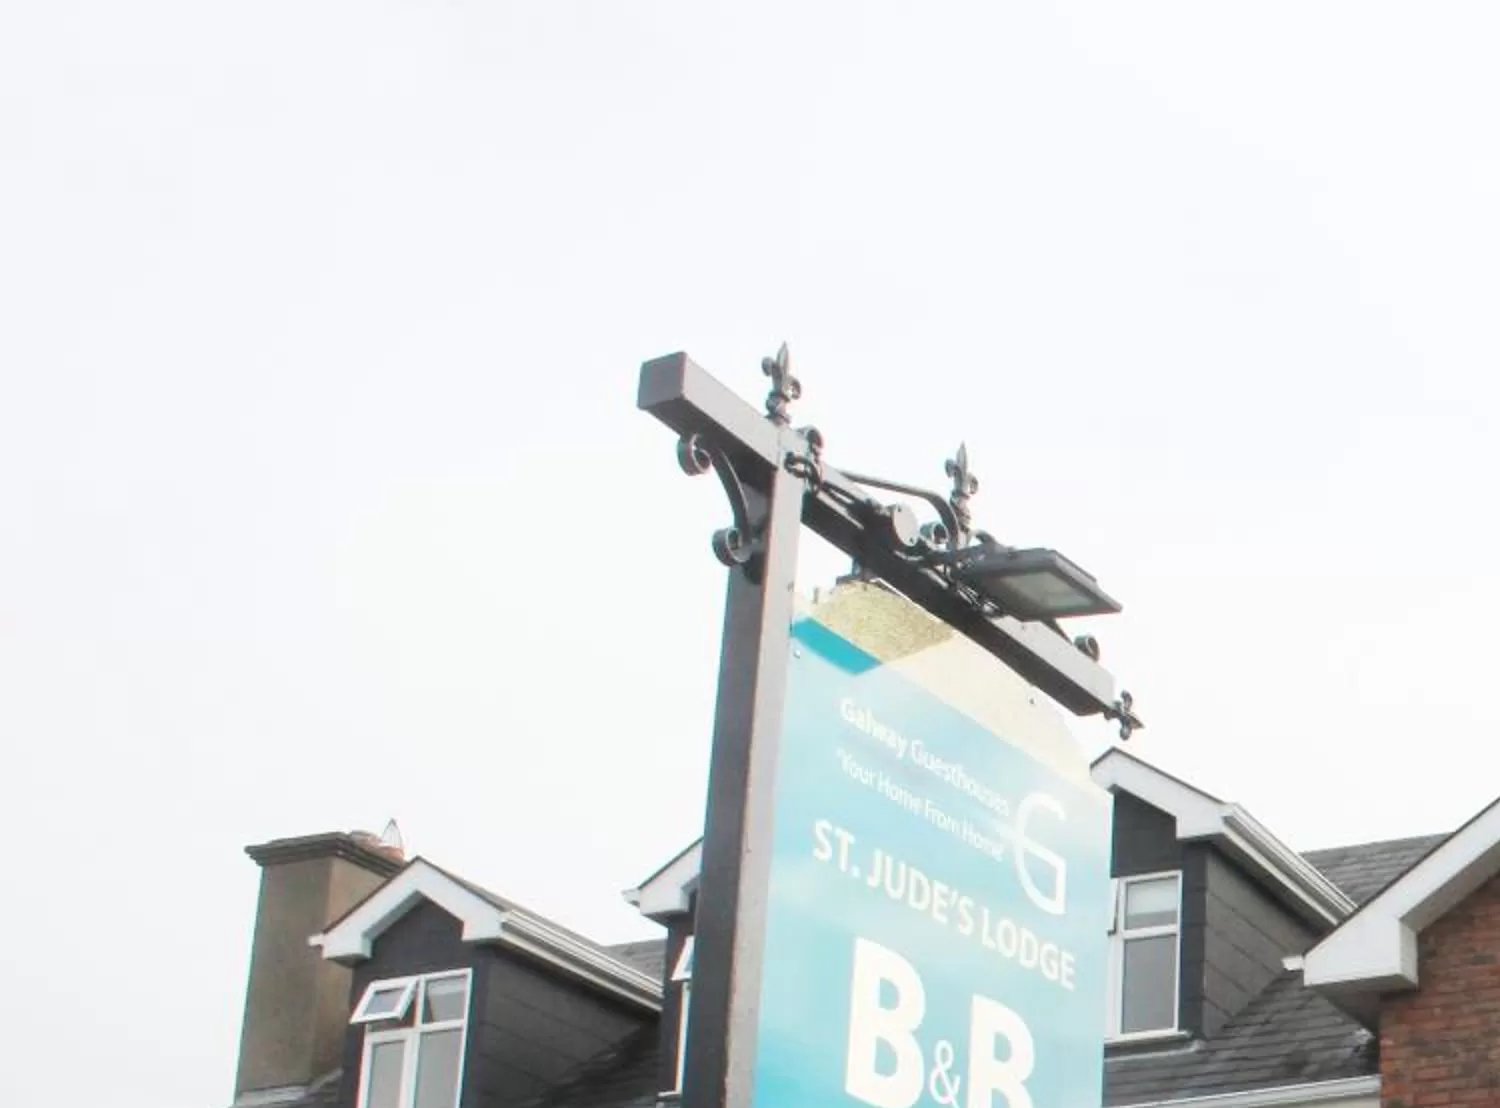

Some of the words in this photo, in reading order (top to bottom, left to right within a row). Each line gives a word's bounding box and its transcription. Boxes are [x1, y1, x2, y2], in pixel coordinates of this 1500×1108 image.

[840, 698, 907, 760] Galway
[878, 771, 921, 816] Home
[924, 798, 961, 839] From
[813, 818, 861, 878] ST.
[866, 847, 975, 937] JUDE'S
[981, 904, 1076, 992] LODGE
